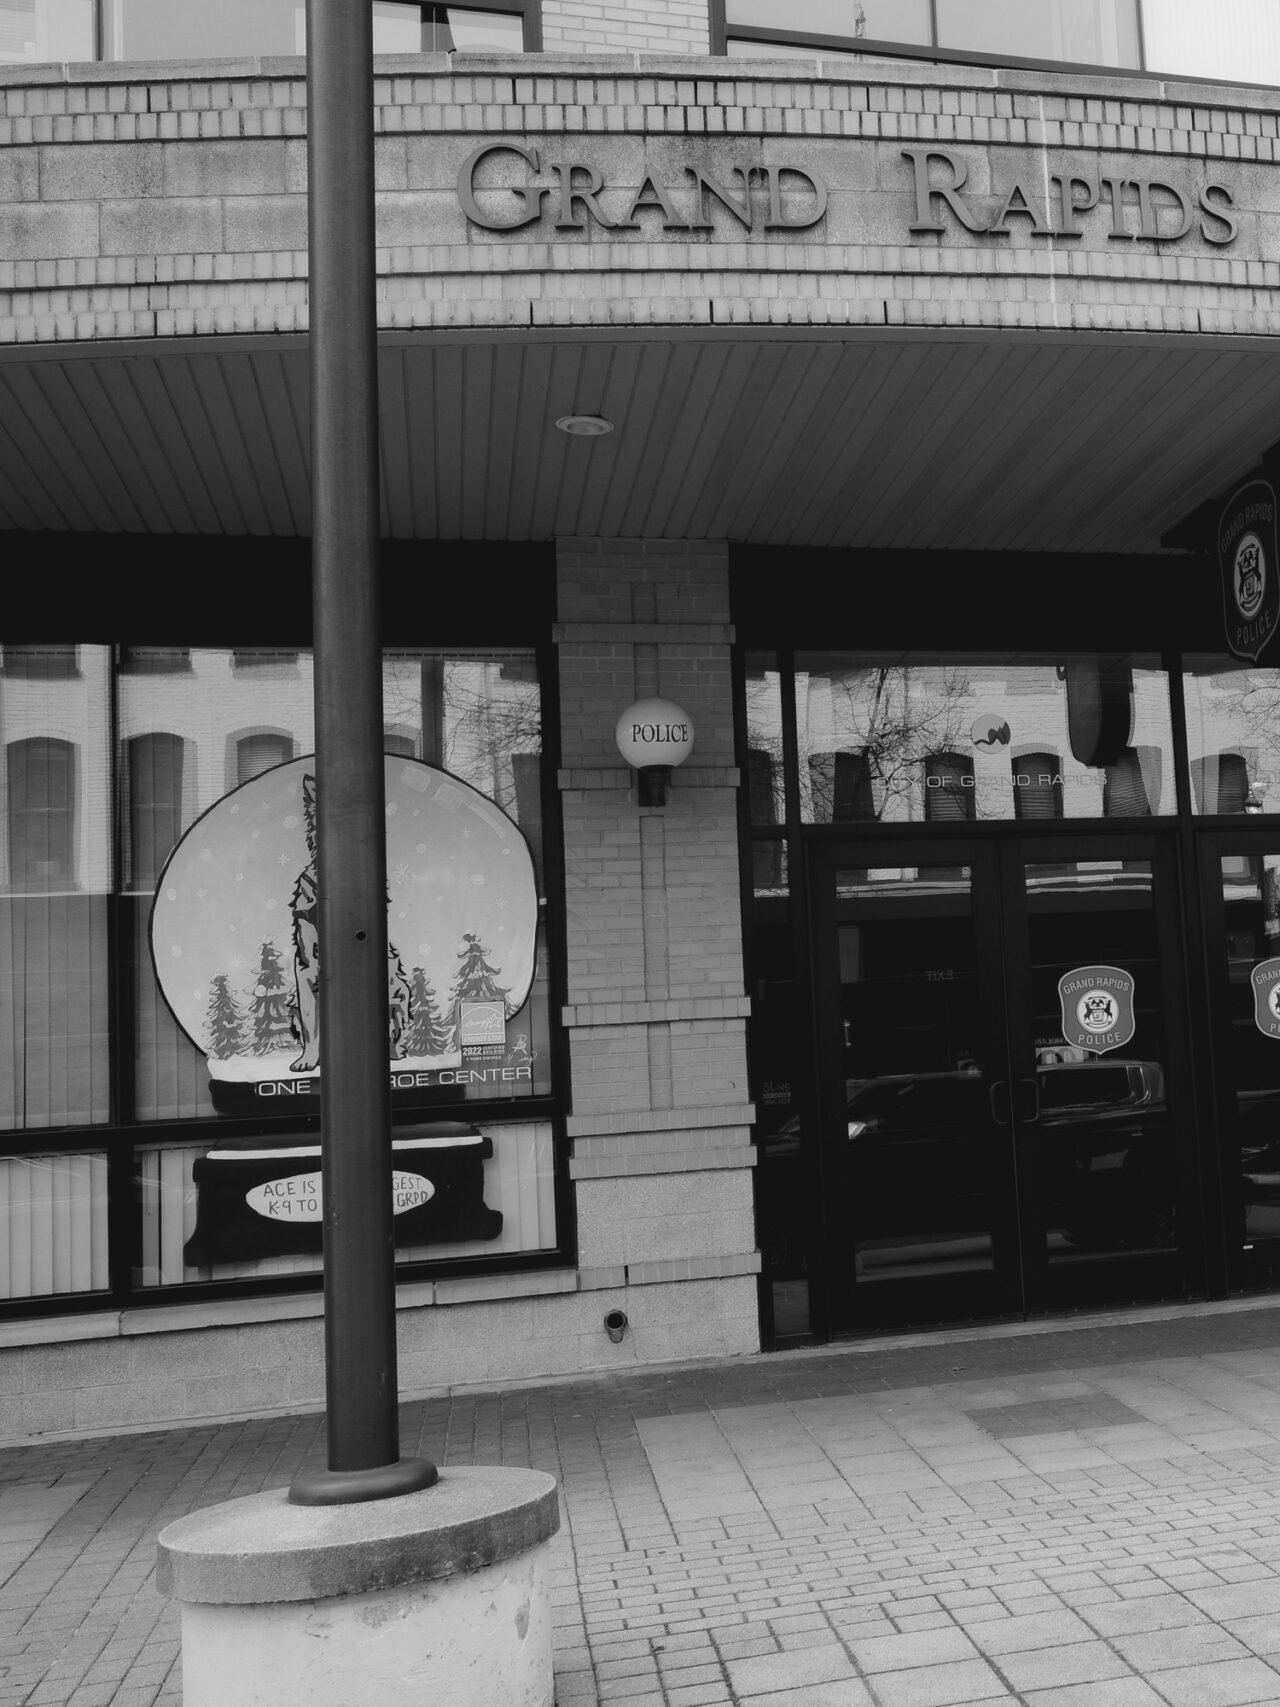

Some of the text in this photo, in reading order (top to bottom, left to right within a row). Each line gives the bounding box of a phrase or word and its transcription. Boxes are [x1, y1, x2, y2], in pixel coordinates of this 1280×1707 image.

[456, 142, 828, 231] GRAND
[901, 149, 1238, 246] RAPIDS
[1221, 503, 1273, 553] GRAND RAPIDS
[1237, 610, 1271, 645] POLICE
[632, 724, 689, 742] POLICE
[927, 775, 952, 788] OF
[960, 774, 1031, 787] GRAND
[1038, 774, 1107, 786] RAPIDS
[1063, 977, 1129, 994] GRAND RAPIDS
[1079, 1032, 1121, 1045] POLICE
[463, 1047, 482, 1055] 2022
[258, 1080, 311, 1096] ONE
[439, 1066, 532, 1084] CENTER
[264, 1181, 296, 1197] ACE
[303, 1180, 316, 1194] IS
[269, 1191, 428, 1215] K-9 TO GRPD
